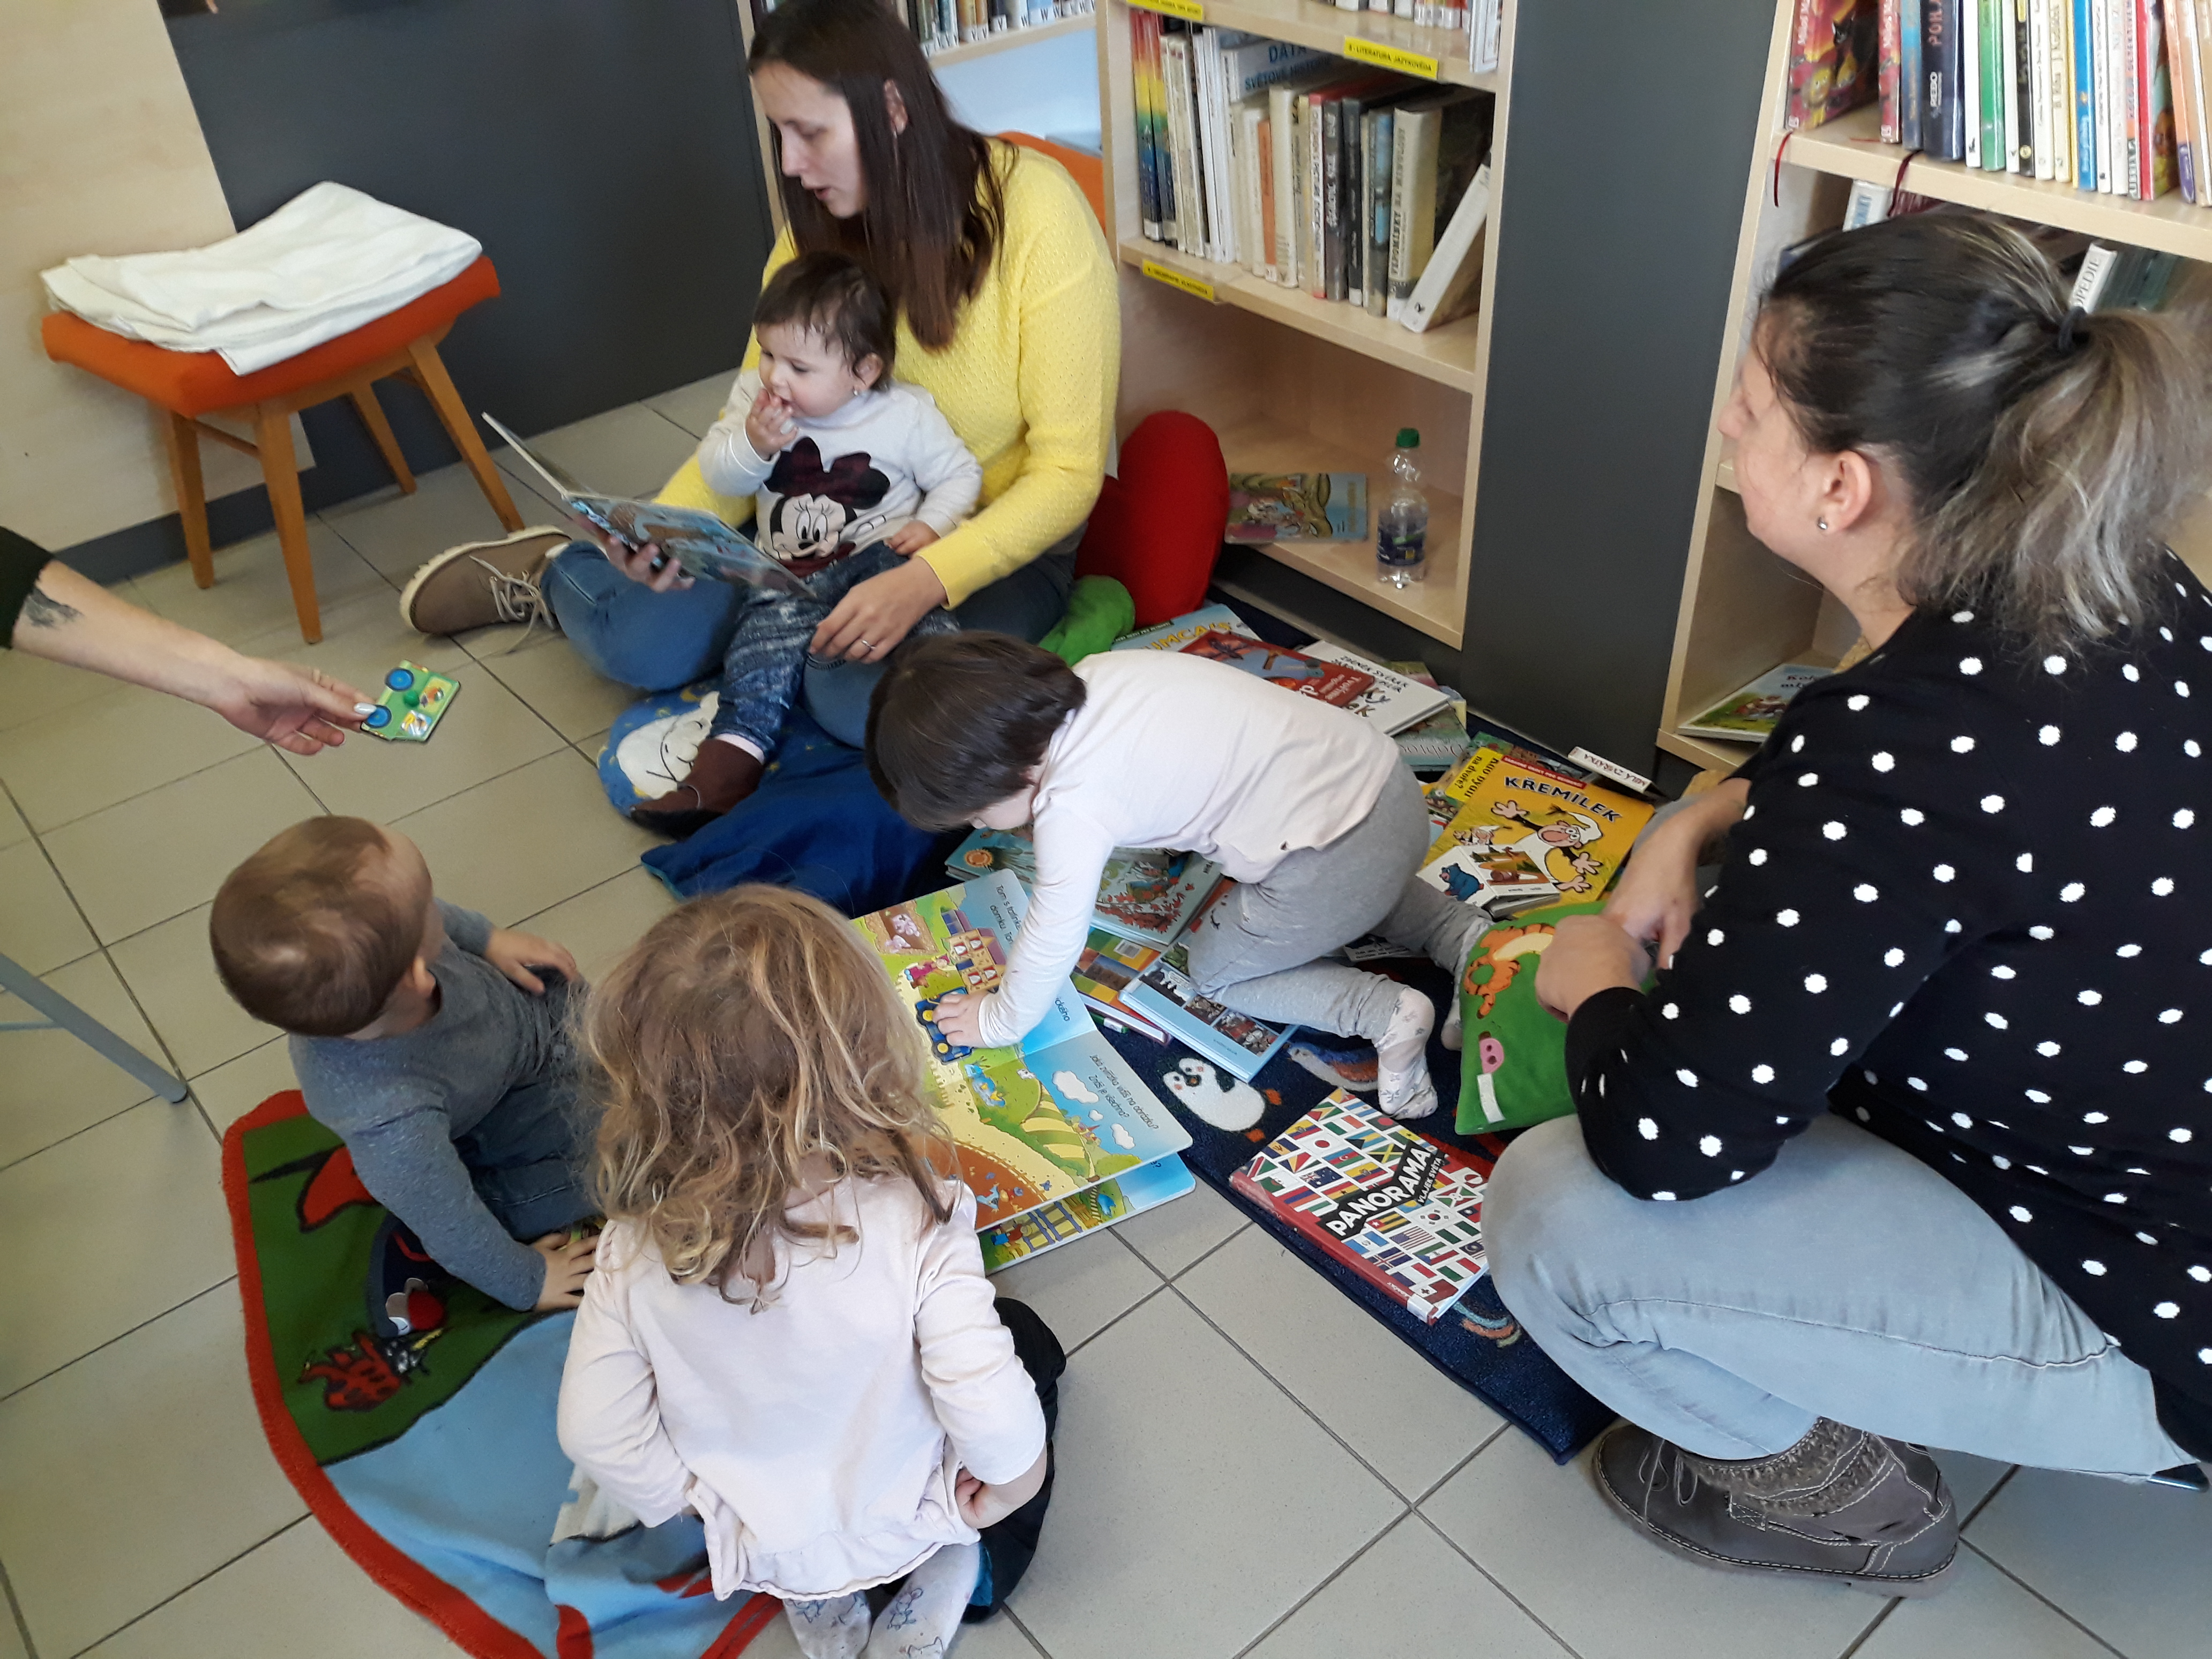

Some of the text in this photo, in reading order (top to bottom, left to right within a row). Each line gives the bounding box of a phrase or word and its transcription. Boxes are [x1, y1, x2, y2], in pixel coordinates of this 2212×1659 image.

[1503, 776, 1622, 822] KŘEMÍLEK
[996, 885, 1007, 899] Tom
[1127, 1097, 1136, 1105] na
[1326, 1148, 1431, 1236] PANORAMA
[1417, 1157, 1442, 1204] VLAJEK SVĚTA
